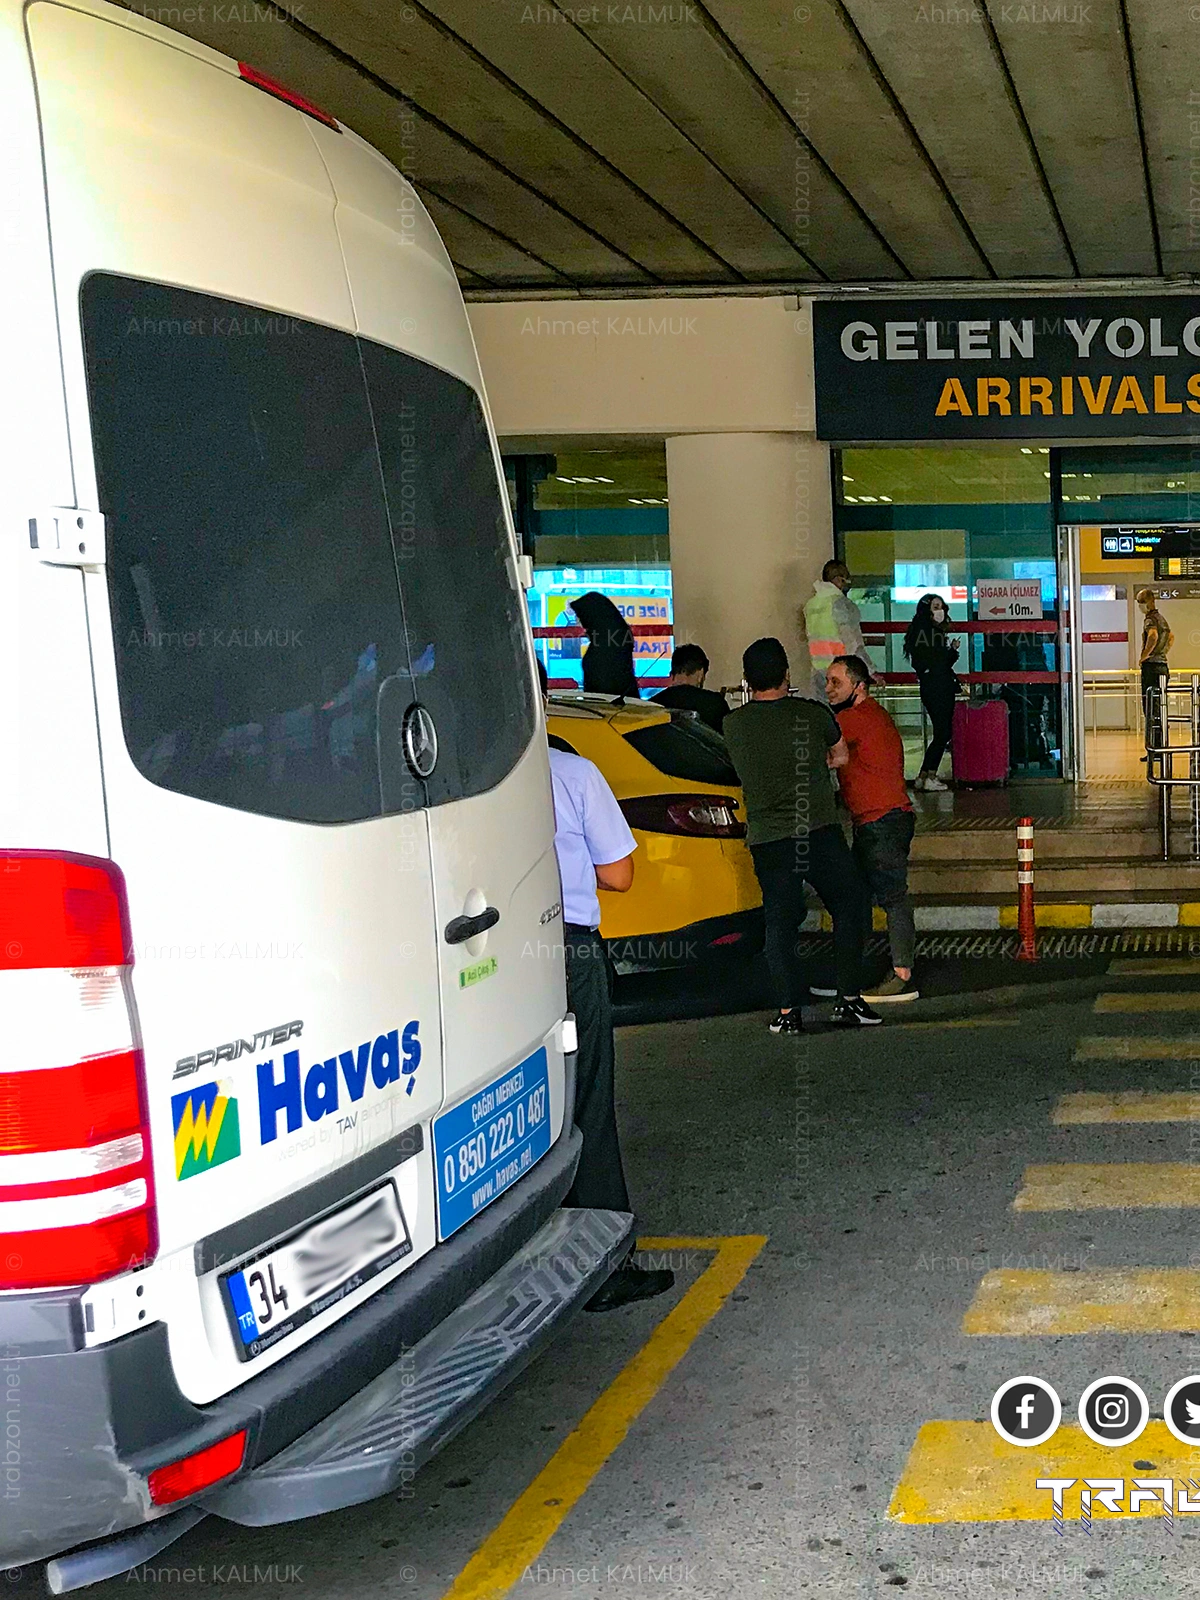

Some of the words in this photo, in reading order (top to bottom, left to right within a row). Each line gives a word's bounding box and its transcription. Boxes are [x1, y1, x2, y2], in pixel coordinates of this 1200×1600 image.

[841, 320, 1035, 362] GELEN
[980, 585, 1009, 598] SİGARA
[1009, 585, 1039, 600] İÇİLMEZ
[1008, 603, 1034, 616] 10m.
[172, 1019, 304, 1081] SPRINTER
[256, 1019, 422, 1146] Havaş
[471, 1093, 495, 1128] ÇAĞRI
[495, 1066, 525, 1107] MERKEZİ
[336, 1110, 359, 1136] TAV
[443, 1154, 456, 1194] 0
[458, 1130, 487, 1183] 850
[488, 1110, 516, 1161] 222
[516, 1102, 526, 1138] 0
[527, 1083, 546, 1127] 487
[471, 1142, 533, 1209] www.havas.net
[238, 1311, 255, 1330] TR
[249, 1261, 290, 1325] 34
